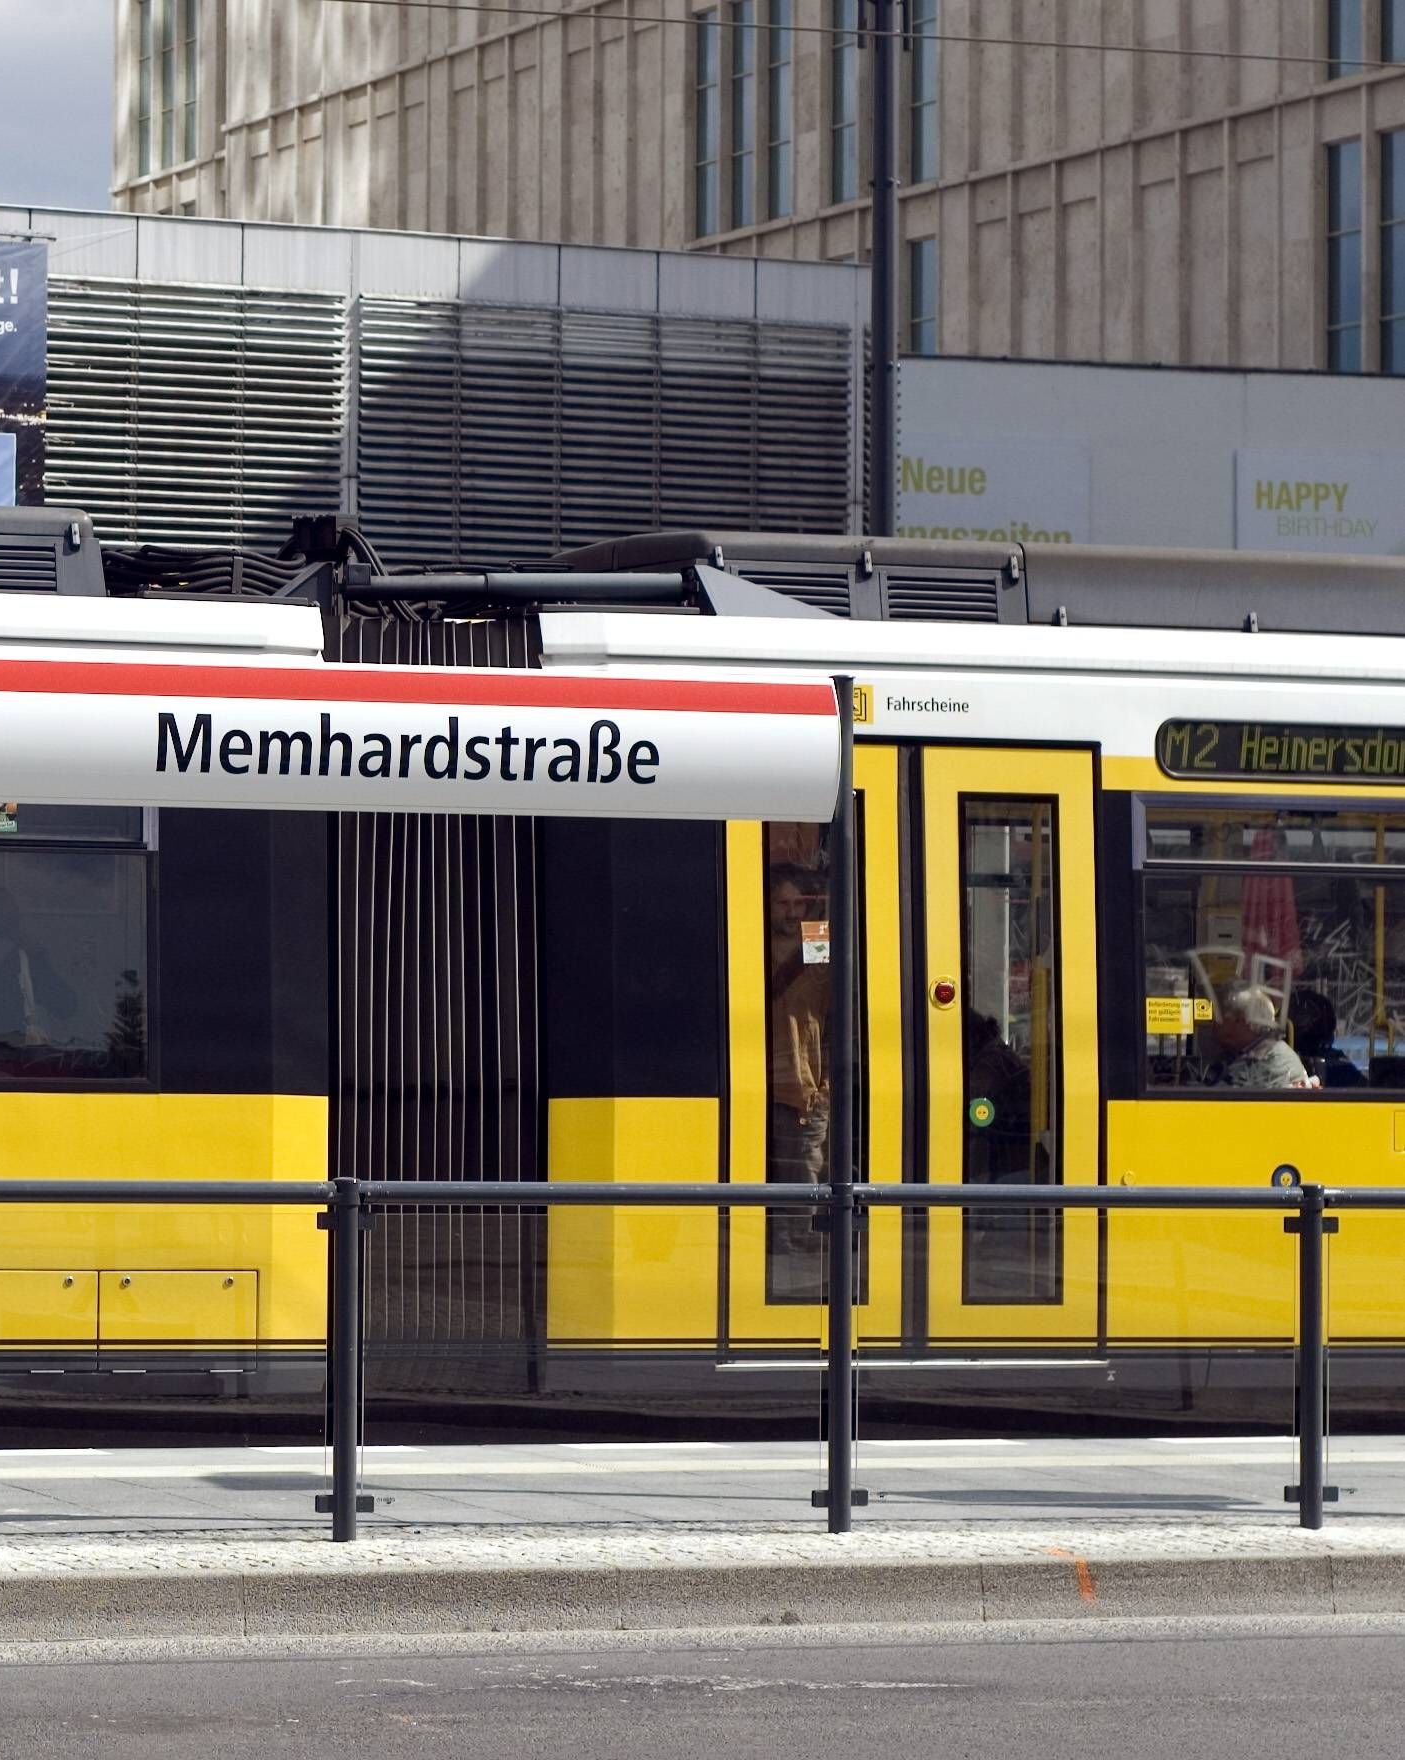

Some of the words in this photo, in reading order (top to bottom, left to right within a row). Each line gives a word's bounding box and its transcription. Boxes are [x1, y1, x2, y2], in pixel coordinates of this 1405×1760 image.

[901, 456, 987, 495] Neue
[1255, 479, 1348, 513] HAPPY
[1276, 515, 1379, 538] BIRTHDAY
[887, 697, 970, 713] Fahrscheine
[156, 712, 660, 784] Memhardstraße
[1165, 724, 1219, 768] M2
